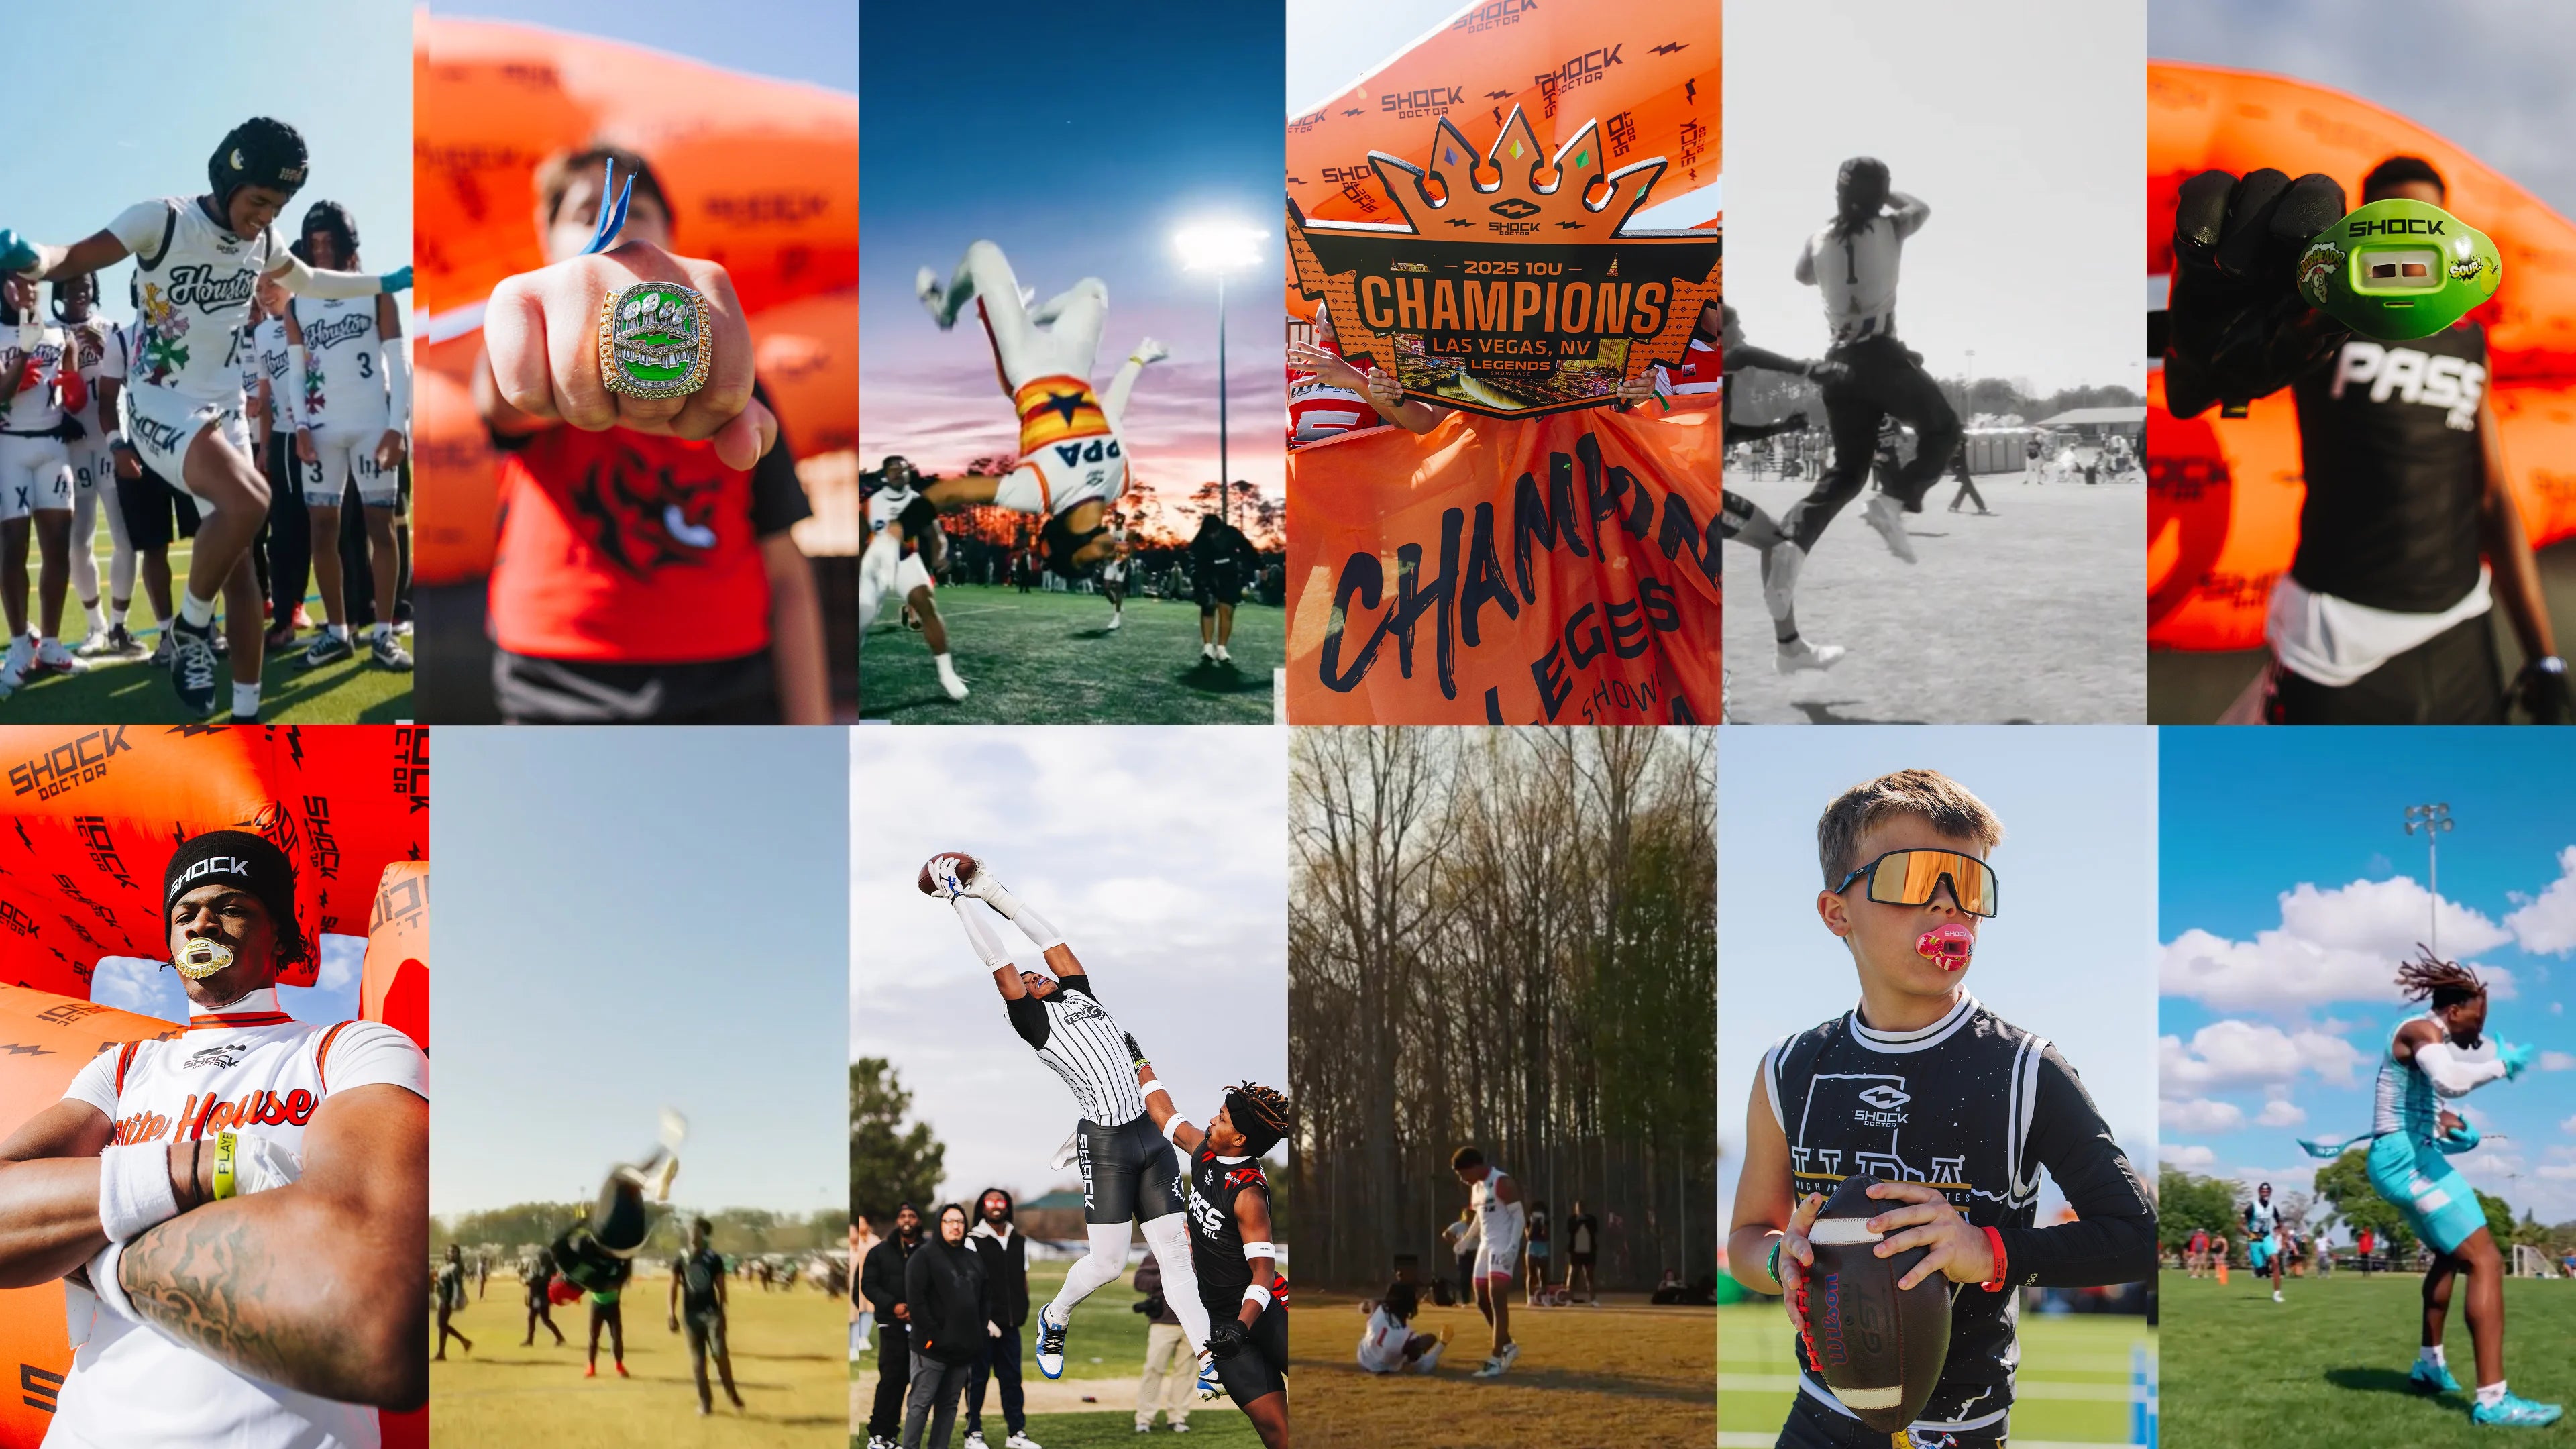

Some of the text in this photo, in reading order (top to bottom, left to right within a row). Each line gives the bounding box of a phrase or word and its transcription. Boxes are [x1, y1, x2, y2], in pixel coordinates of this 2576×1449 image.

[1468, 15, 1520, 34] DOCTOR
[1381, 86, 1465, 112] SHOCK
[1399, 107, 1449, 119] DOCTOR
[1322, 165, 1376, 184] SHO
[1489, 221, 1541, 232] SHOCK
[2349, 219, 2446, 237] SHOCK
[1464, 260, 1562, 276] 2025 10U
[2297, 248, 2344, 280] WARHEADS
[2449, 257, 2483, 279] SOUR!
[1360, 275, 1668, 335] CHAMPIONS
[305, 313, 373, 350] Houston
[1433, 337, 1591, 357] LAS VEGAS, NV
[356, 352, 374, 379] 3
[1471, 360, 1550, 371] LEGENDS
[78, 468, 93, 488] 9
[8, 724, 133, 797] SHOCK
[37, 763, 108, 802] DOCTOR
[303, 795, 341, 881] SHOCK
[168, 856, 249, 902] SHOCK
[187, 942, 209, 950] SHOCK
[183, 1055, 241, 1069] SHOCK
[173, 1088, 319, 1144] House
[1854, 1110, 1909, 1124] SHOCK
[1078, 1134, 1095, 1210] SHOCK
[1796, 1180, 1821, 1192] HIGH
[1202, 1228, 1218, 1240] ATL
[1821, 1272, 1849, 1366] Wilson
